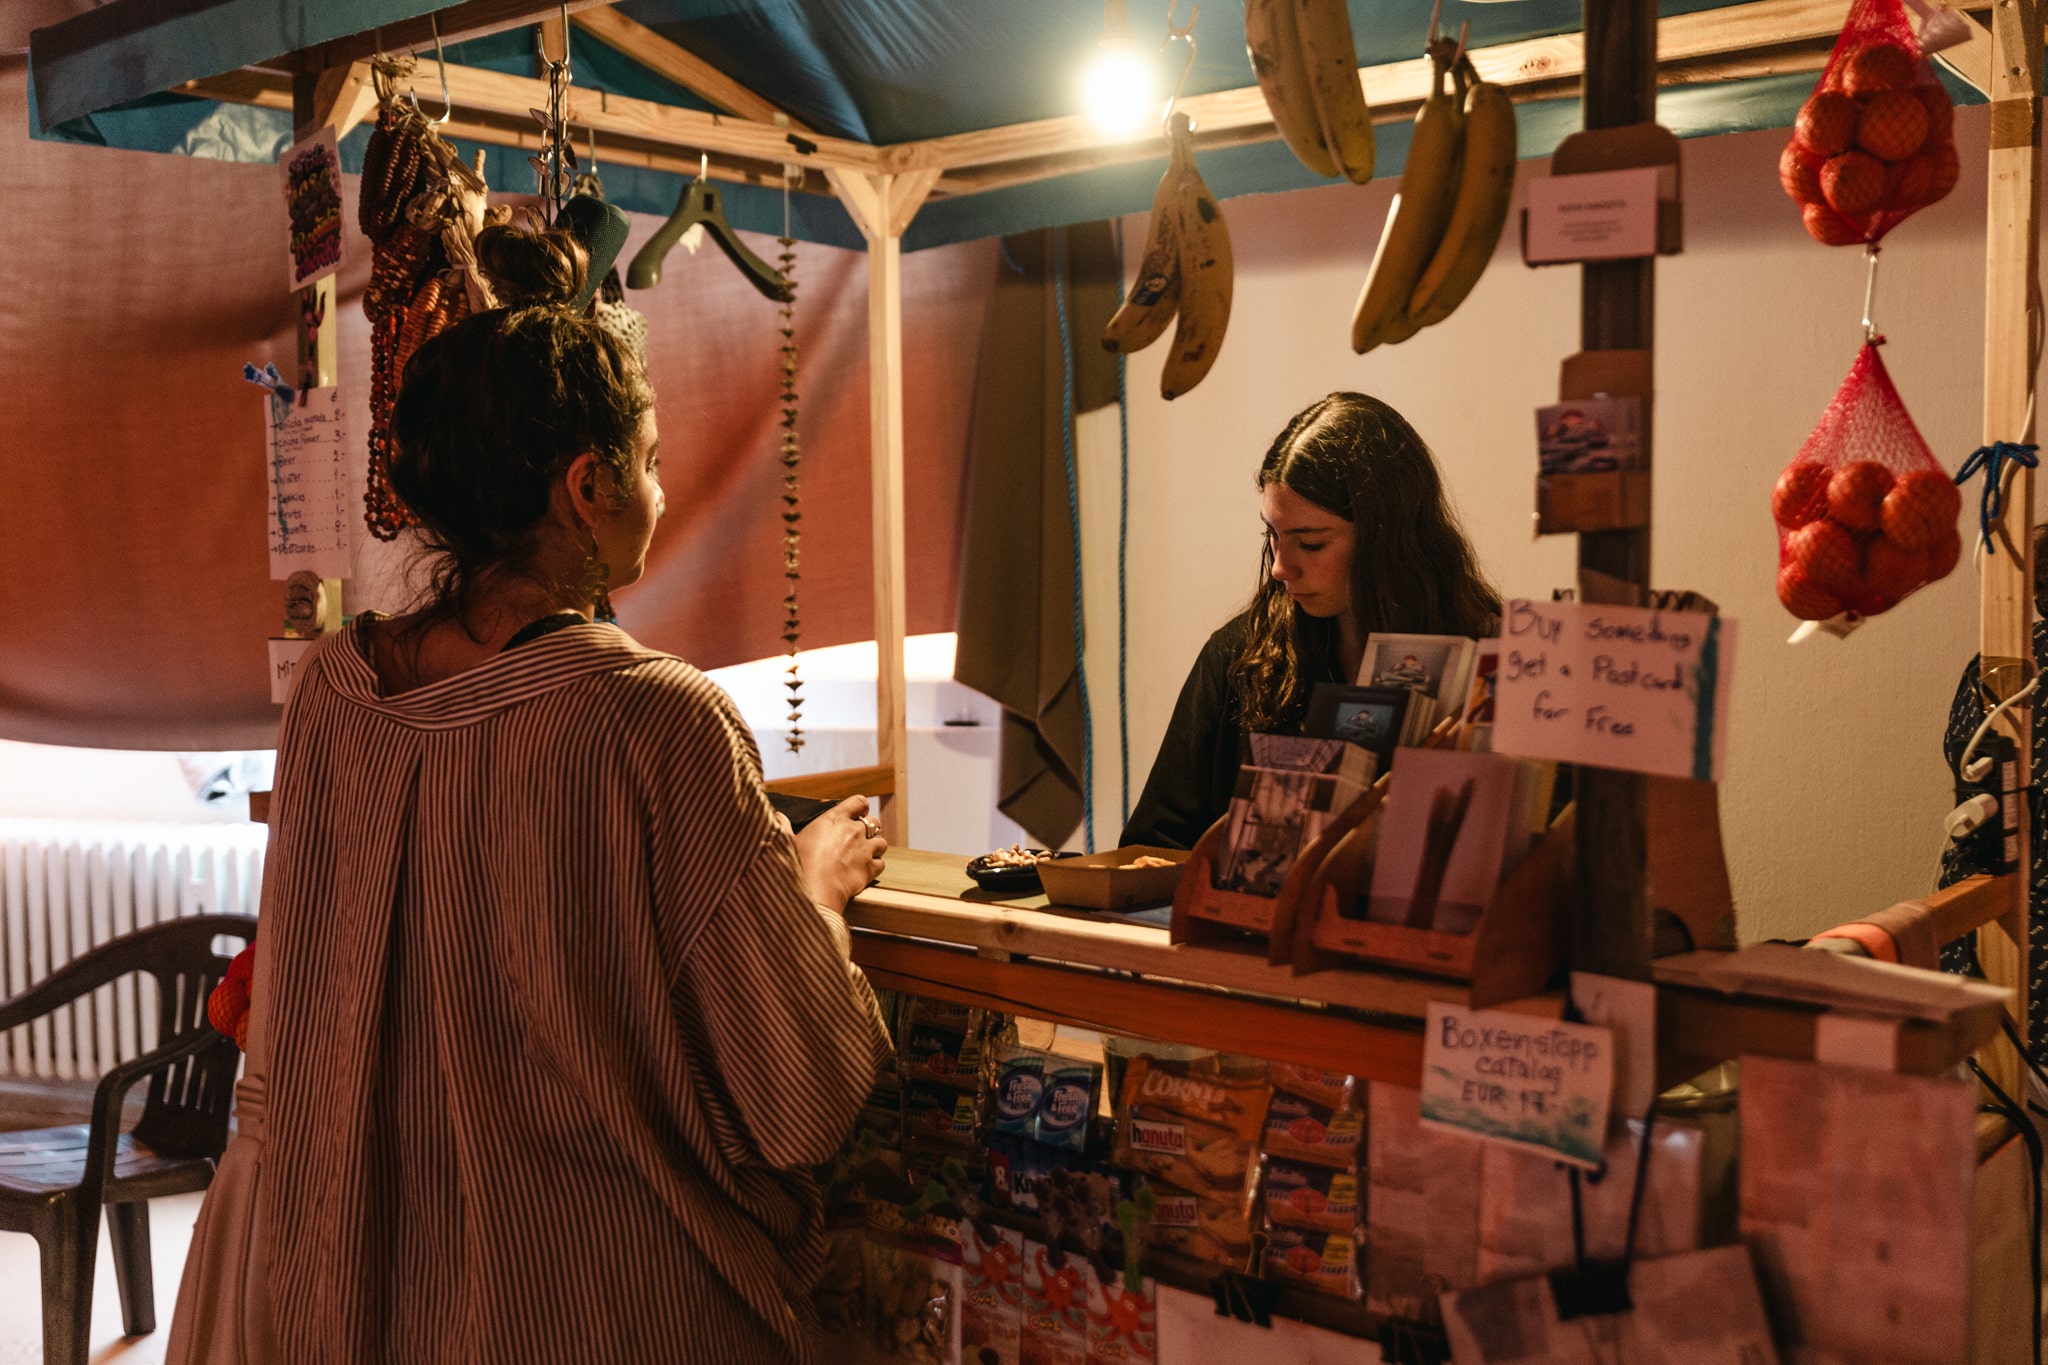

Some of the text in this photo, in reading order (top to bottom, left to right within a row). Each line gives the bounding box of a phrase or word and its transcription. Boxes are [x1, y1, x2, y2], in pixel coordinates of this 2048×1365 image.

[1508, 599, 1562, 645] Buy
[1506, 650, 1547, 683] get
[1585, 704, 1635, 736] Free
[1133, 1120, 1184, 1149] hanuta
[1154, 1201, 1196, 1220] anuta
